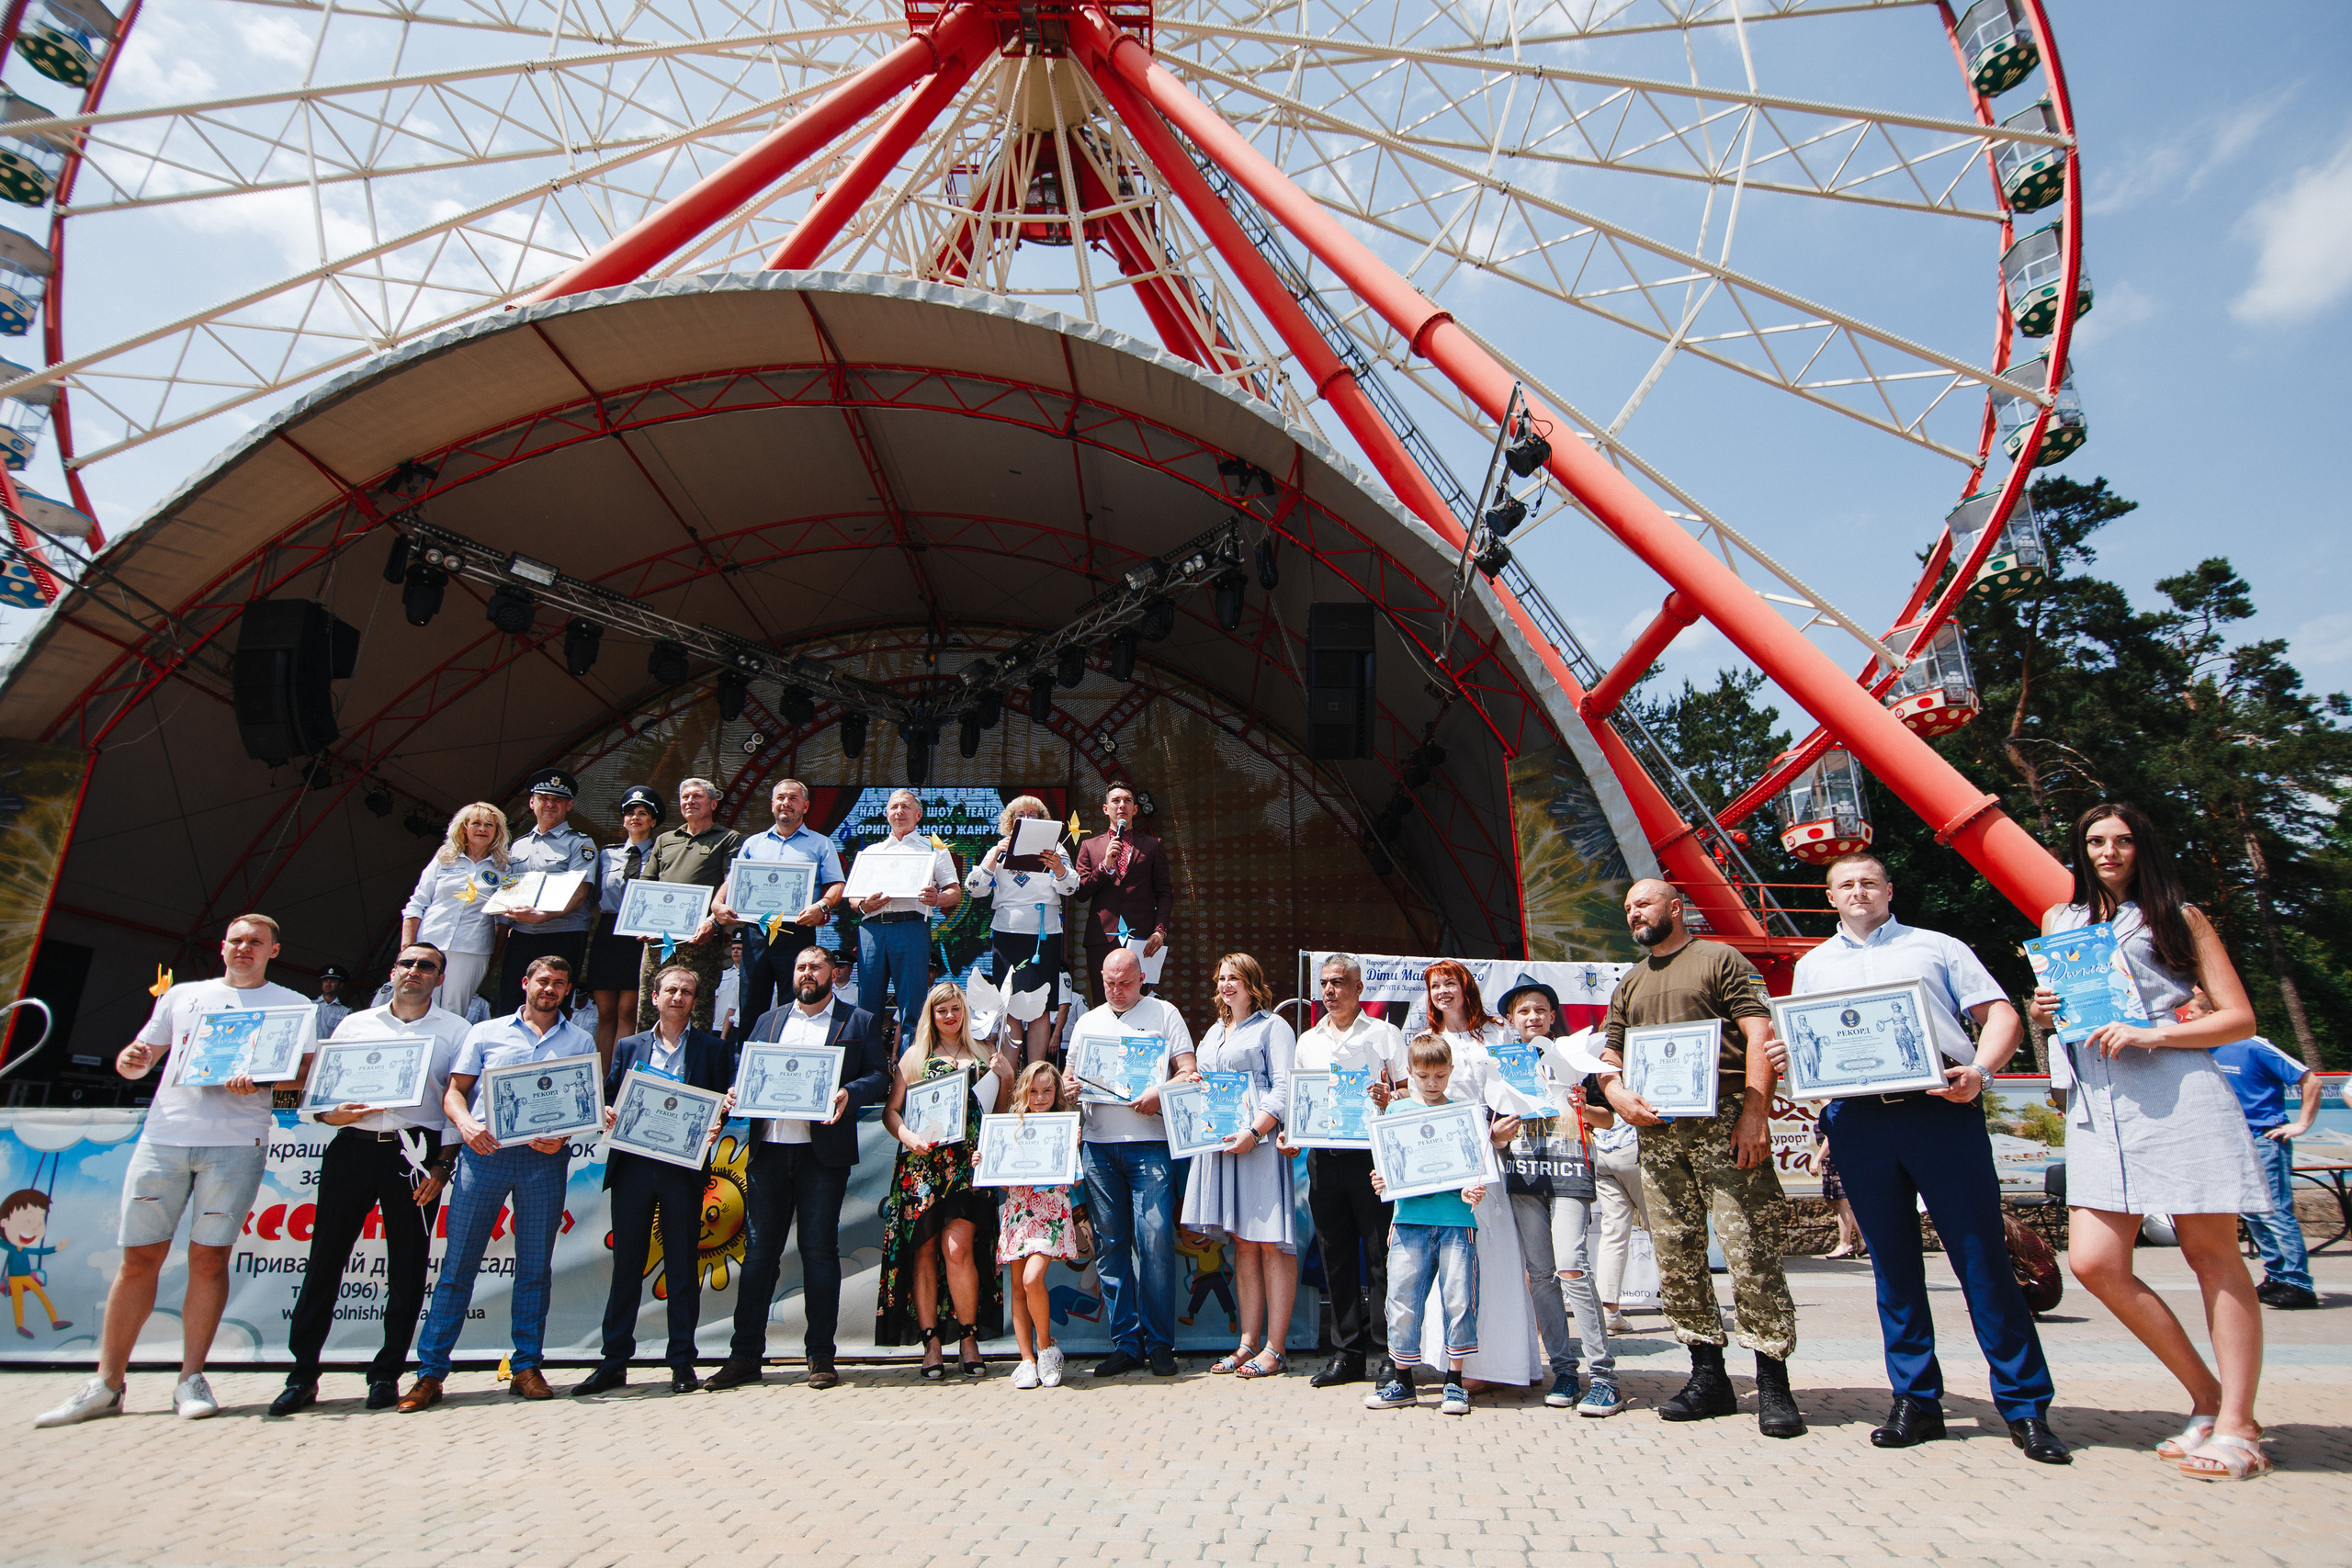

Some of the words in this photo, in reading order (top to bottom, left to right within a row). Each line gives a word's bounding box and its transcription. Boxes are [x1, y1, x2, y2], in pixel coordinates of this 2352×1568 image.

[927, 807, 954, 818] ШОУ
[966, 807, 997, 818] ТЕАТР
[956, 825, 998, 835] ЖАНРУ
[1366, 968, 1398, 981] Діти
[1837, 1027, 1871, 1037] РЕКОРД
[533, 1089, 559, 1099] РЕКОРД
[655, 1109, 679, 1120] РЕКОРД
[1418, 1138, 1443, 1146] РЕКОРД
[1507, 1160, 1585, 1178] DISTRICT
[339, 1281, 379, 1302] 096)
